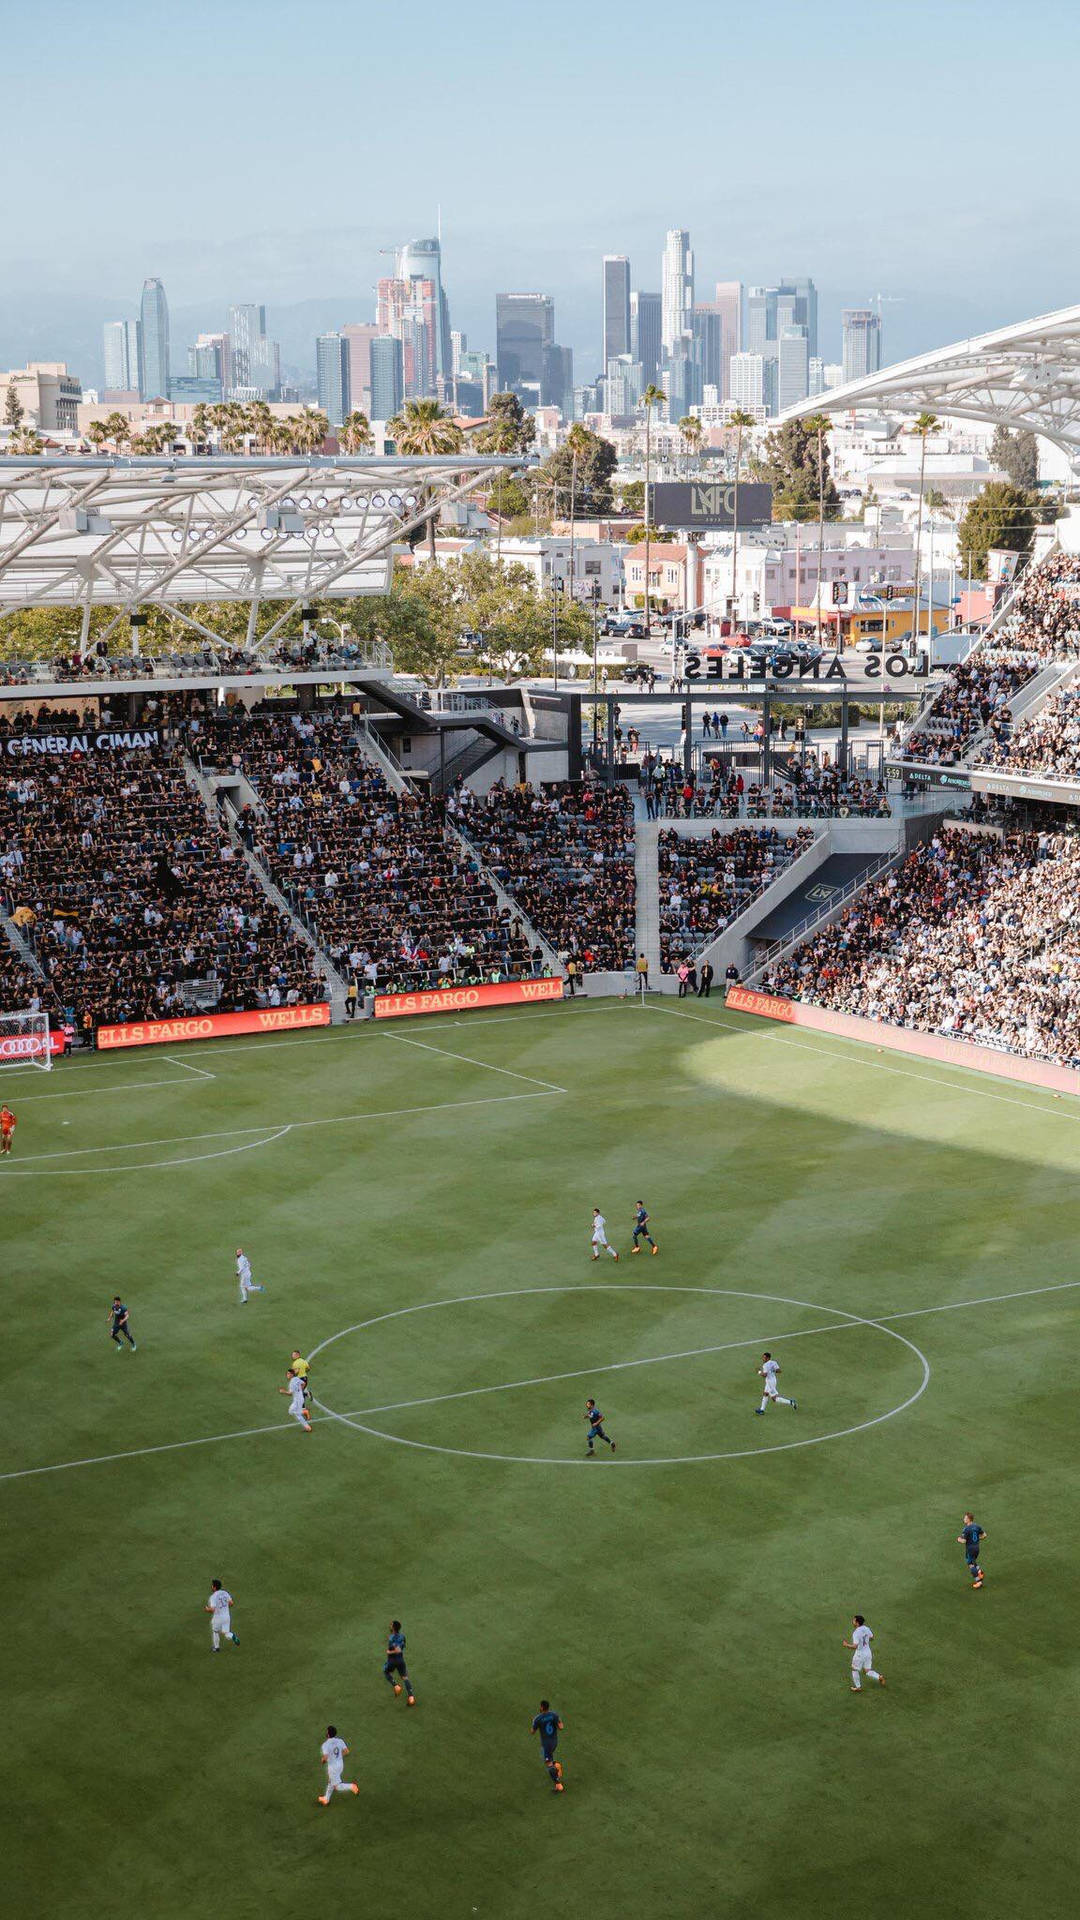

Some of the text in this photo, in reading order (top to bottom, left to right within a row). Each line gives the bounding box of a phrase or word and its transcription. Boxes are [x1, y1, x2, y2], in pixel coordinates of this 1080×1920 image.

[96, 731, 159, 750] CIMAN
[914, 773, 931, 781] DELTA
[420, 990, 479, 1010] FARGO
[755, 996, 793, 1018] FARGO
[148, 1019, 213, 1040] FARGO
[258, 1007, 324, 1028] WELLS
[545, 1721, 553, 1735] 6
[333, 1746, 340, 1759] 9
